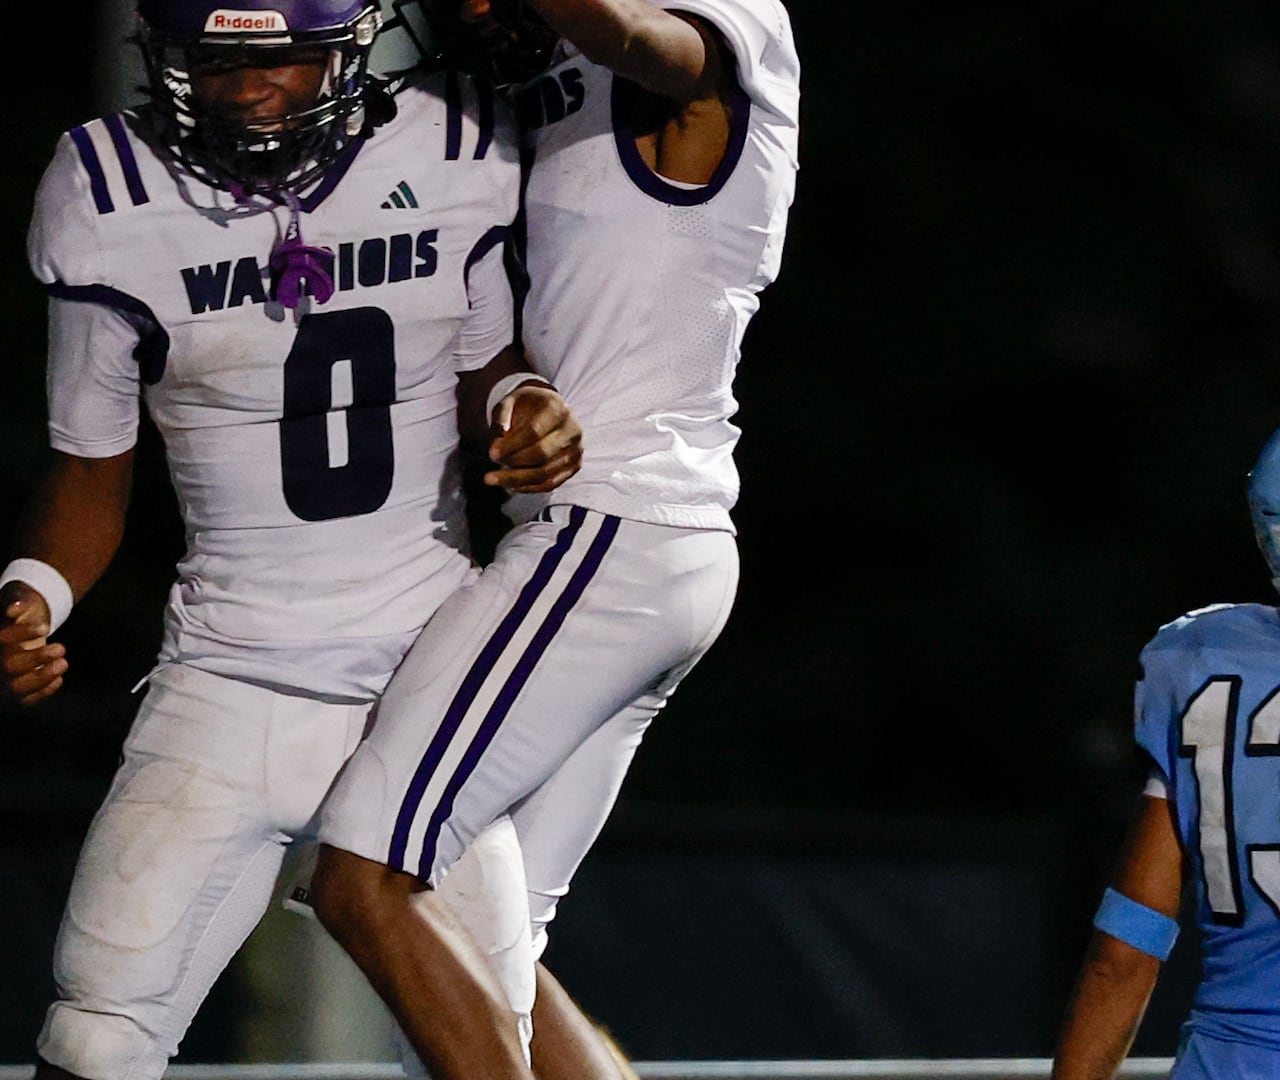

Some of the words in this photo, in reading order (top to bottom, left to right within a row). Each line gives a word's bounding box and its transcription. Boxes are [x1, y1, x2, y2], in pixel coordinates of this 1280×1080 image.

[214, 15, 276, 29] Riddell
[180, 229, 439, 314] WAIORS
[278, 306, 396, 522] 0
